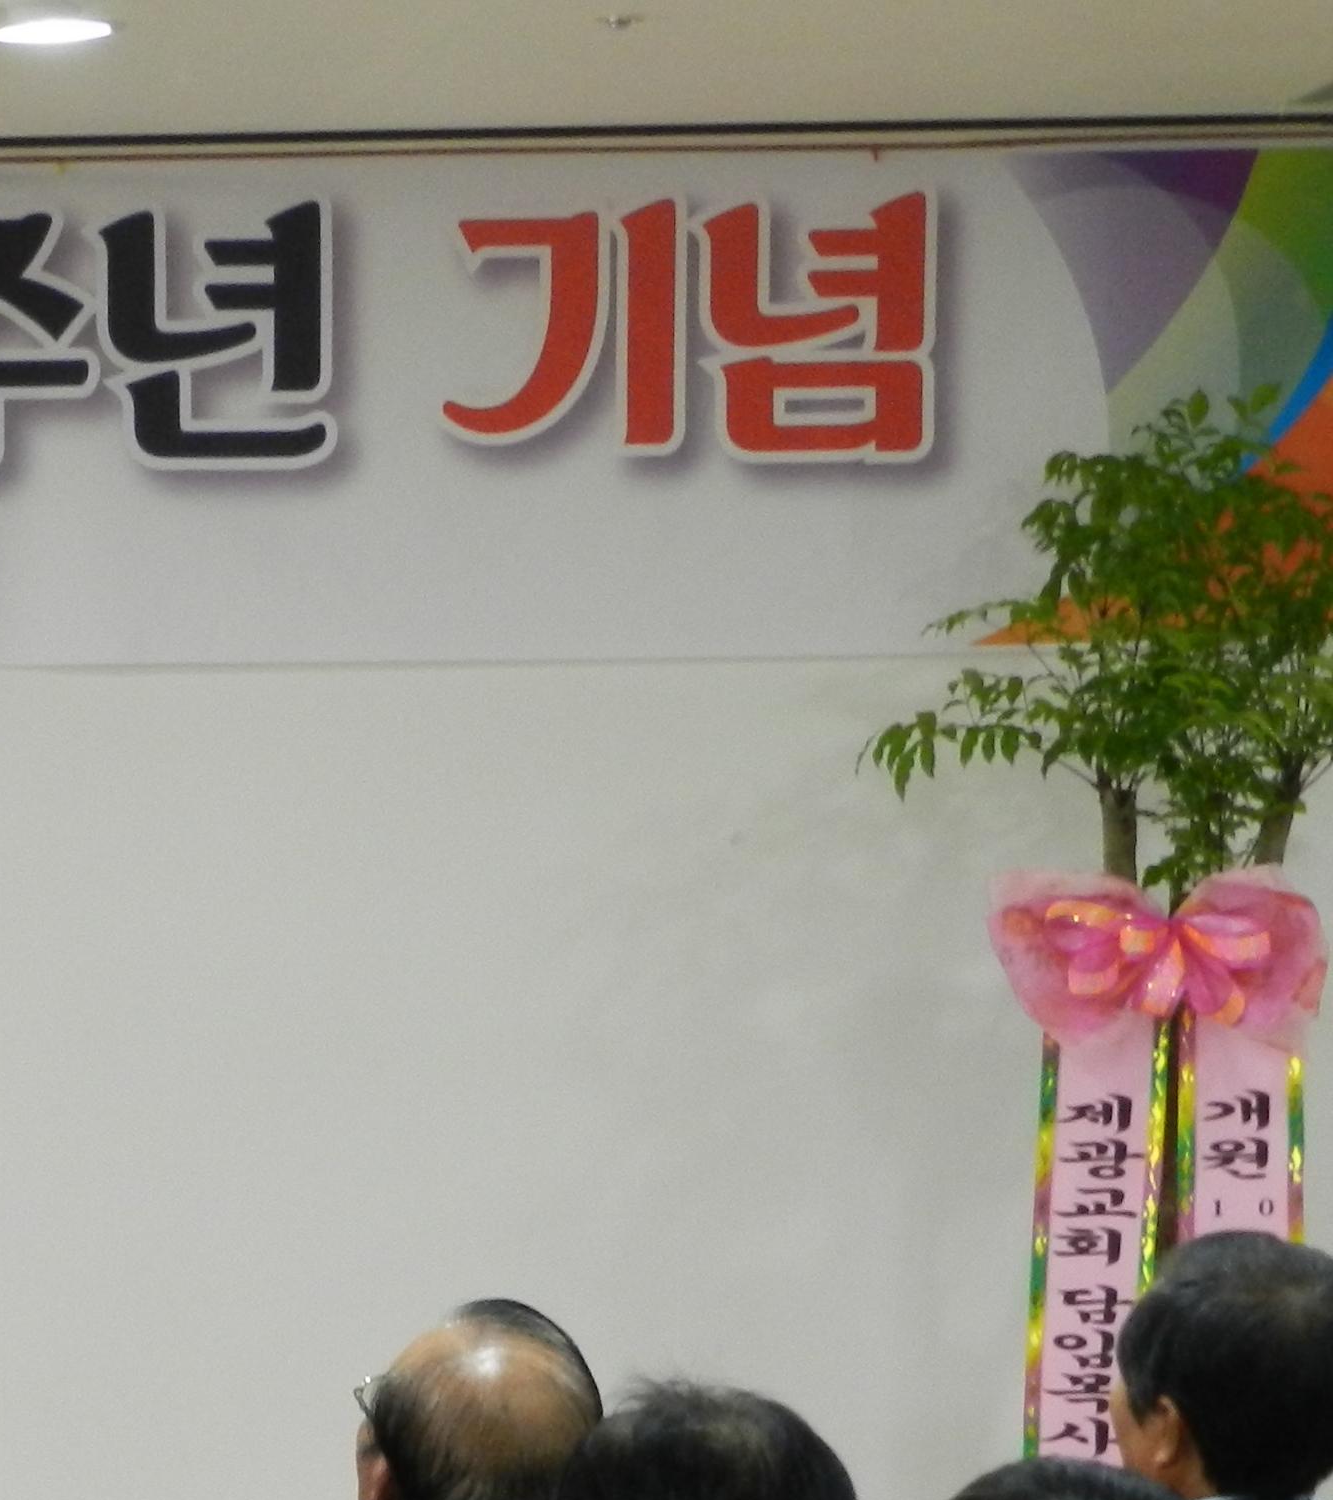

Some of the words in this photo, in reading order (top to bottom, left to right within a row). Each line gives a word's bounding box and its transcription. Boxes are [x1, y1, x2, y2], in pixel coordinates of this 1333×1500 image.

[441, 191, 926, 453] 기념
[1053, 1092, 1146, 1267] 제광교회
[1203, 1088, 1271, 1180] 개원
[1042, 1283, 1134, 1457] 담임목사
